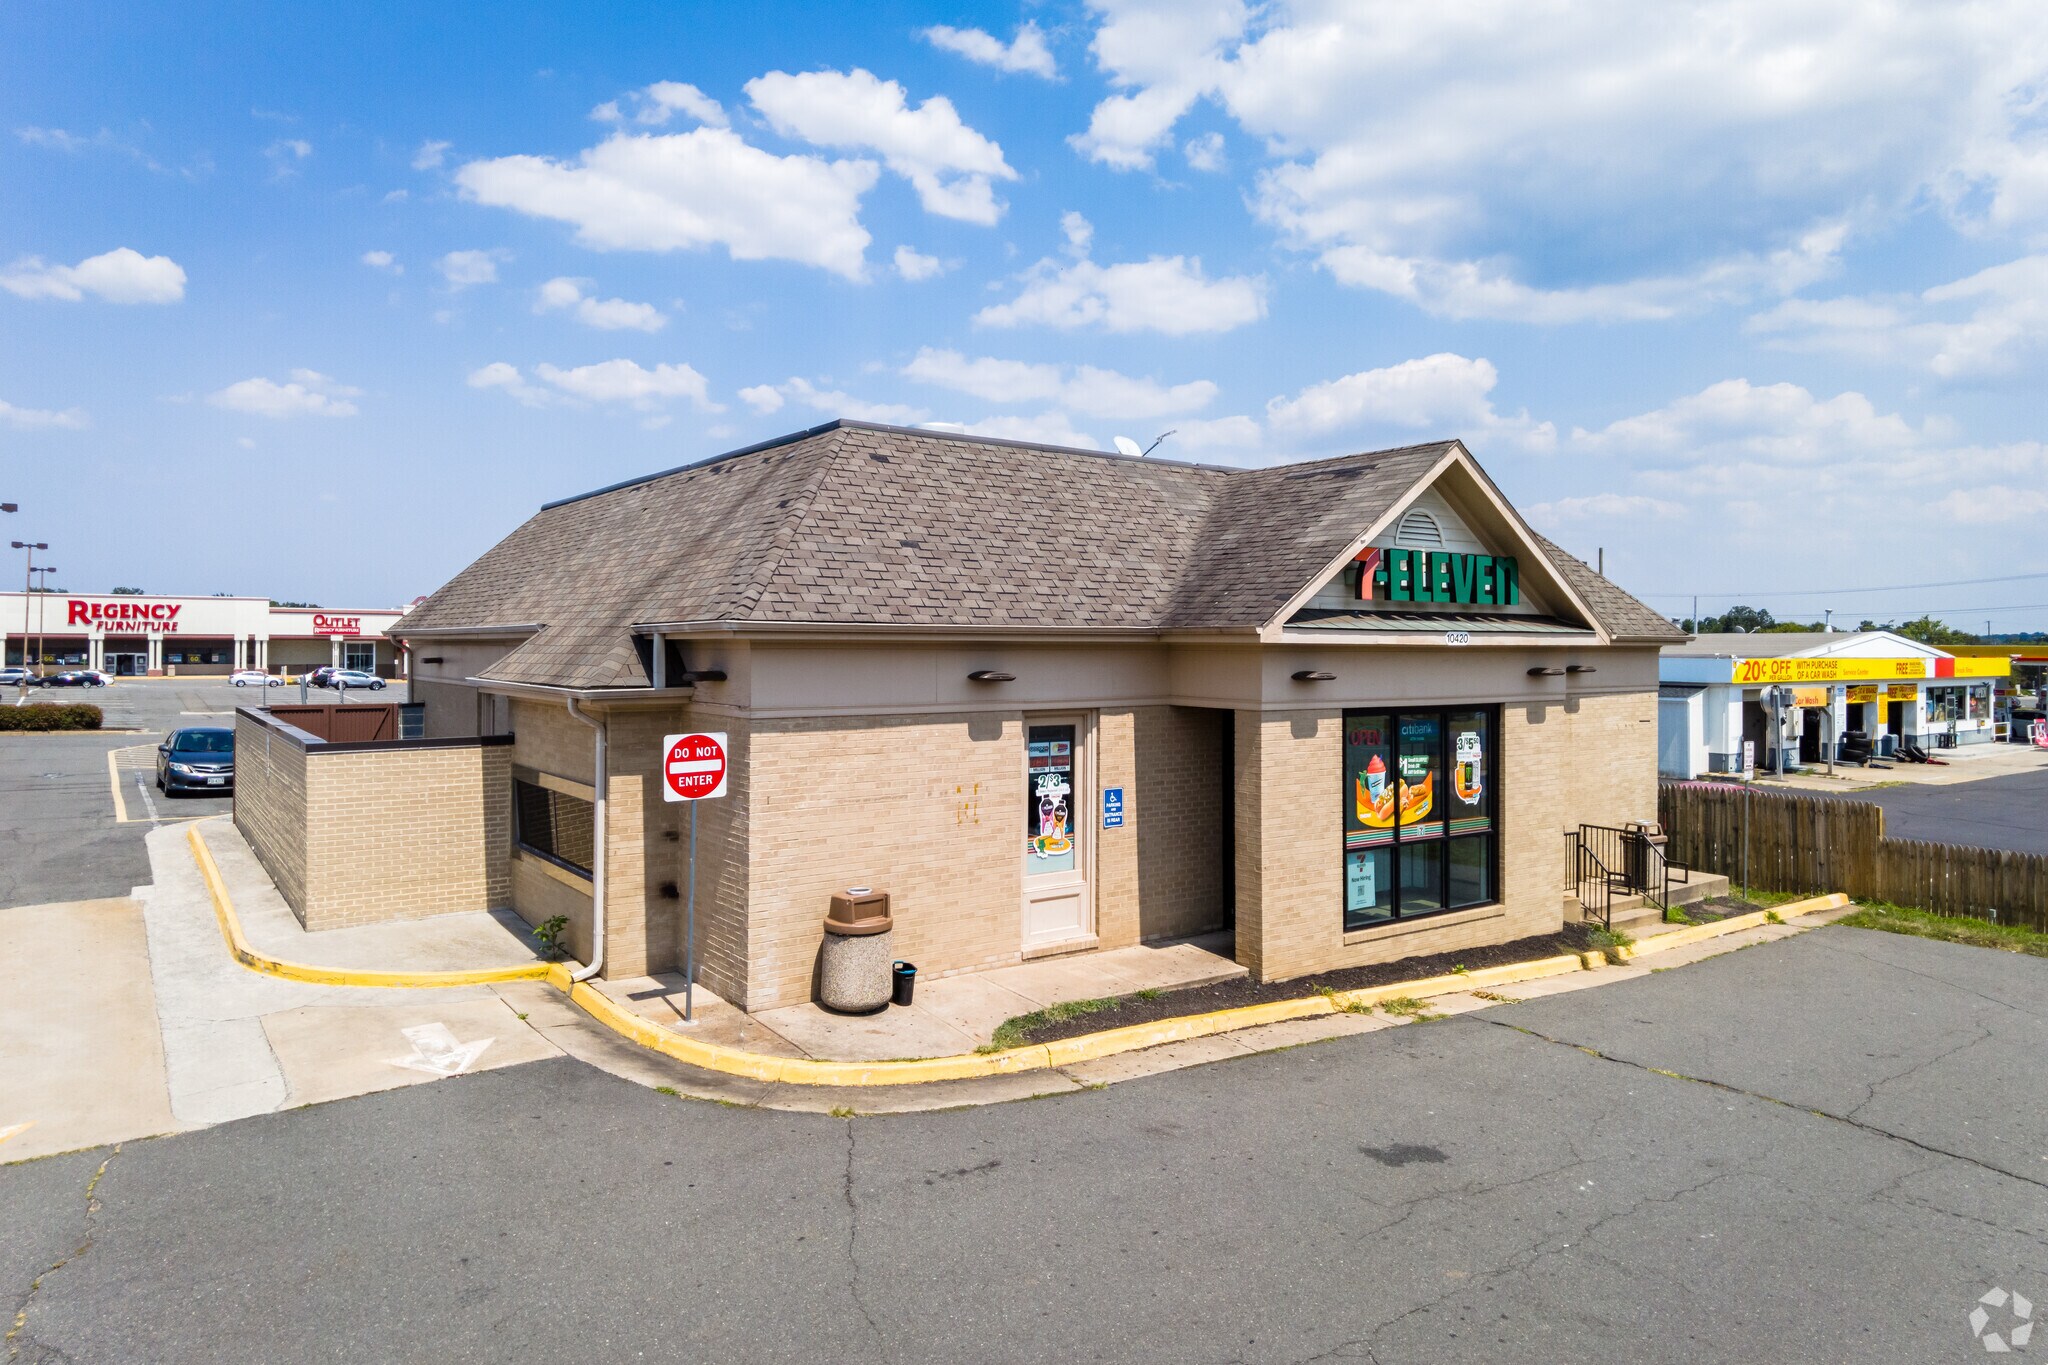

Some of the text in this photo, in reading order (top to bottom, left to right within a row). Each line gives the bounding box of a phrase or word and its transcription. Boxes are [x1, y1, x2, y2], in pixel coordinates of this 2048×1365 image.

[68, 600, 182, 625] REGENCY
[97, 621, 179, 632] FURNITURE
[313, 614, 361, 627] OUTLET
[1447, 633, 1469, 643] 10420
[1771, 661, 1791, 674] OFF
[1796, 660, 1838, 669] WITH PURCHASE
[1896, 662, 1908, 674] FREE
[1797, 670, 1837, 679] OF A CAR WASH
[1401, 723, 1432, 734] citibank
[1350, 729, 1382, 746] OPEN
[675, 746, 717, 758] DO NOT
[678, 775, 713, 787] ENTER
